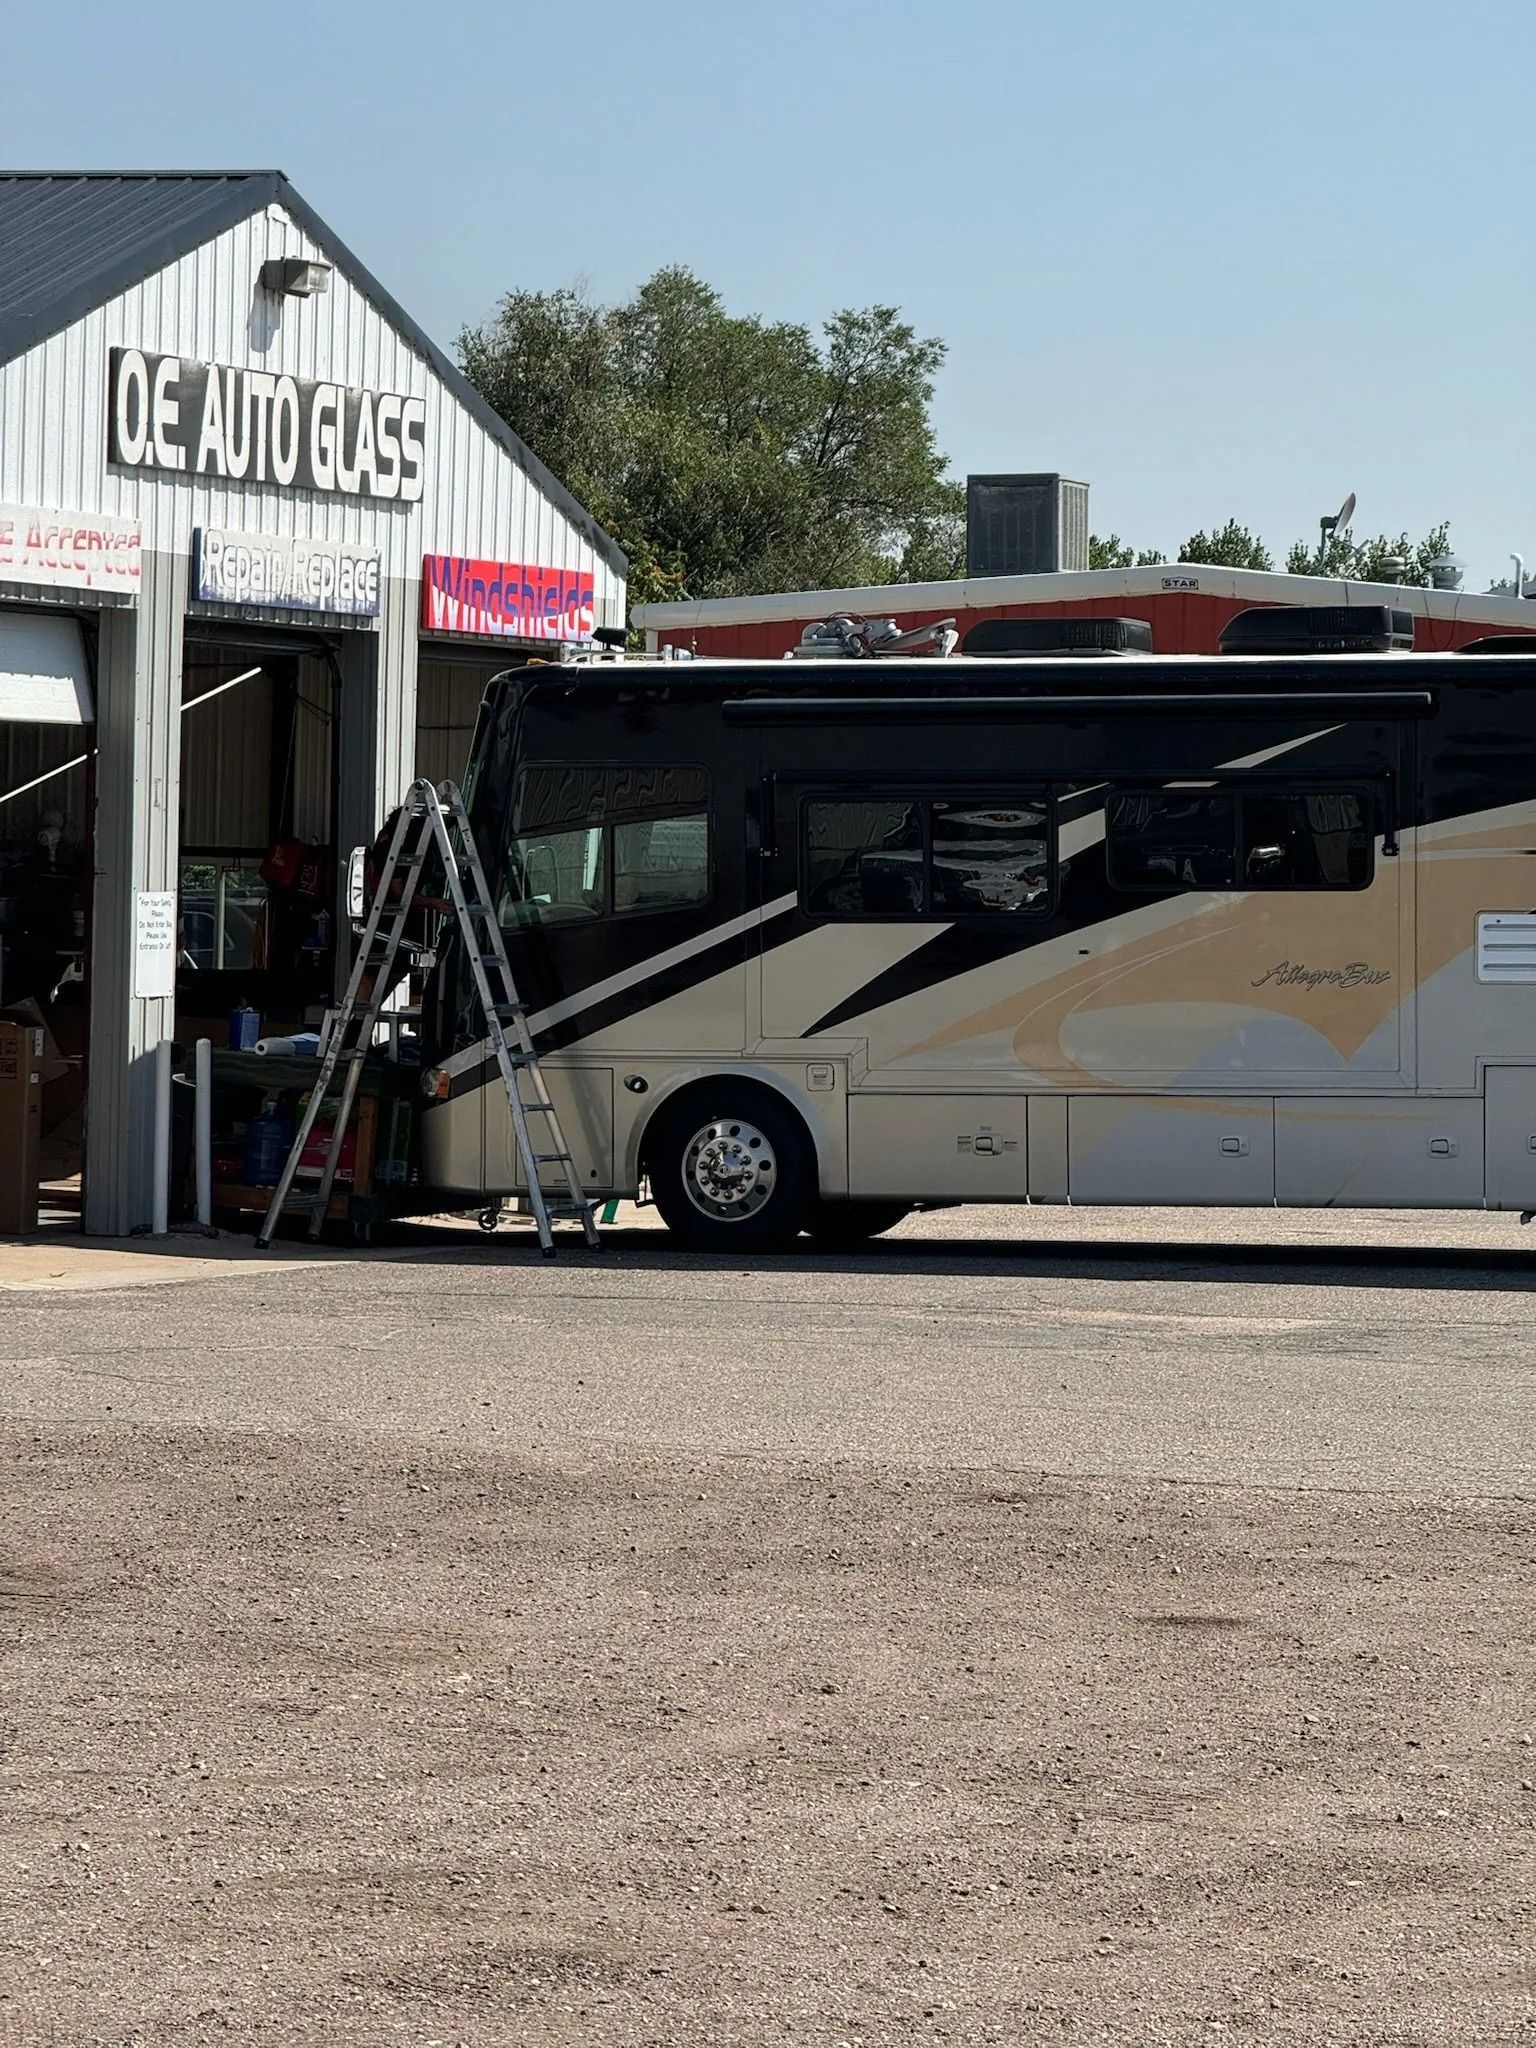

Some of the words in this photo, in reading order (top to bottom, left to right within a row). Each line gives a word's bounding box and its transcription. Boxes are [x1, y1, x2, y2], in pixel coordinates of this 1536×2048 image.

[196, 361, 299, 486] AUTO
[310, 383, 425, 502] GLASS
[430, 554, 594, 642] Windshields
[1164, 579, 1196, 588] STAR
